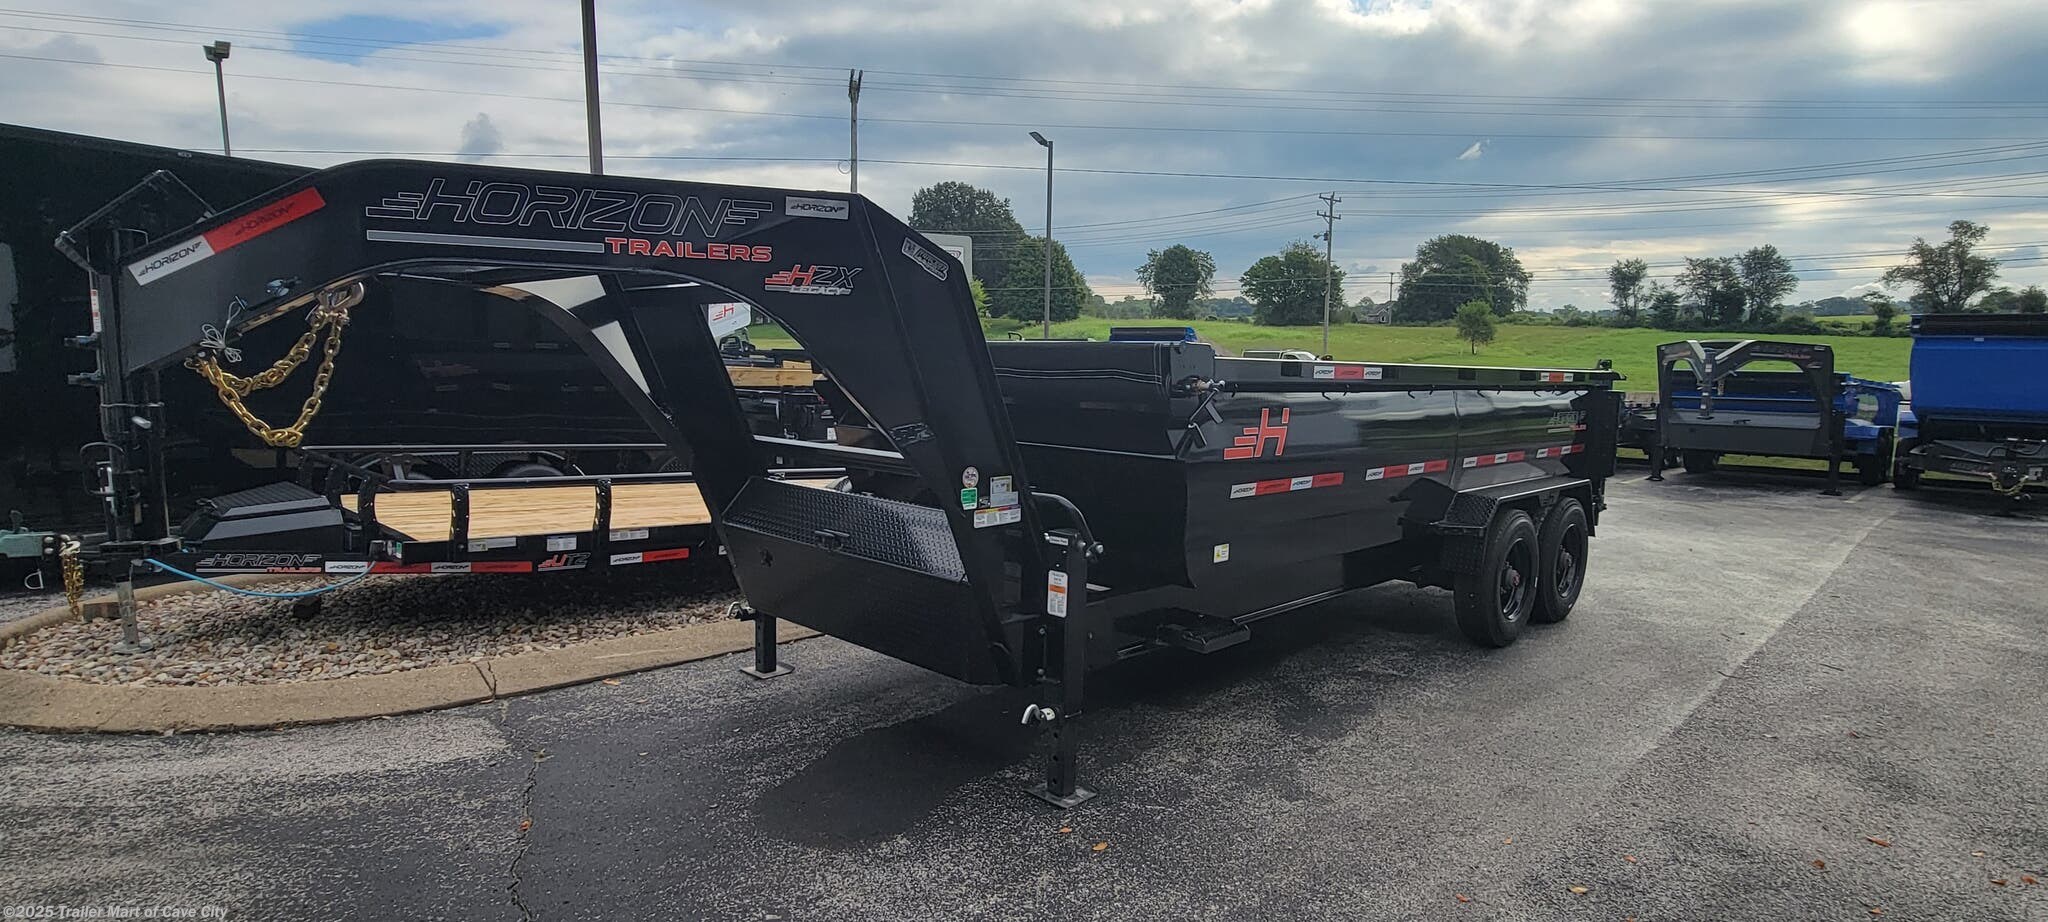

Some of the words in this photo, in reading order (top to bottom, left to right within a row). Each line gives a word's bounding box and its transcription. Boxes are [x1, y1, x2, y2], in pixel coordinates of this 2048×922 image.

[241, 206, 289, 233] HORIZON
[416, 178, 726, 238] HORIZON
[796, 203, 840, 214] HORIZON
[144, 244, 197, 274] HORIZON
[605, 237, 772, 262] TRAILERS
[212, 553, 306, 567] HORIZON
